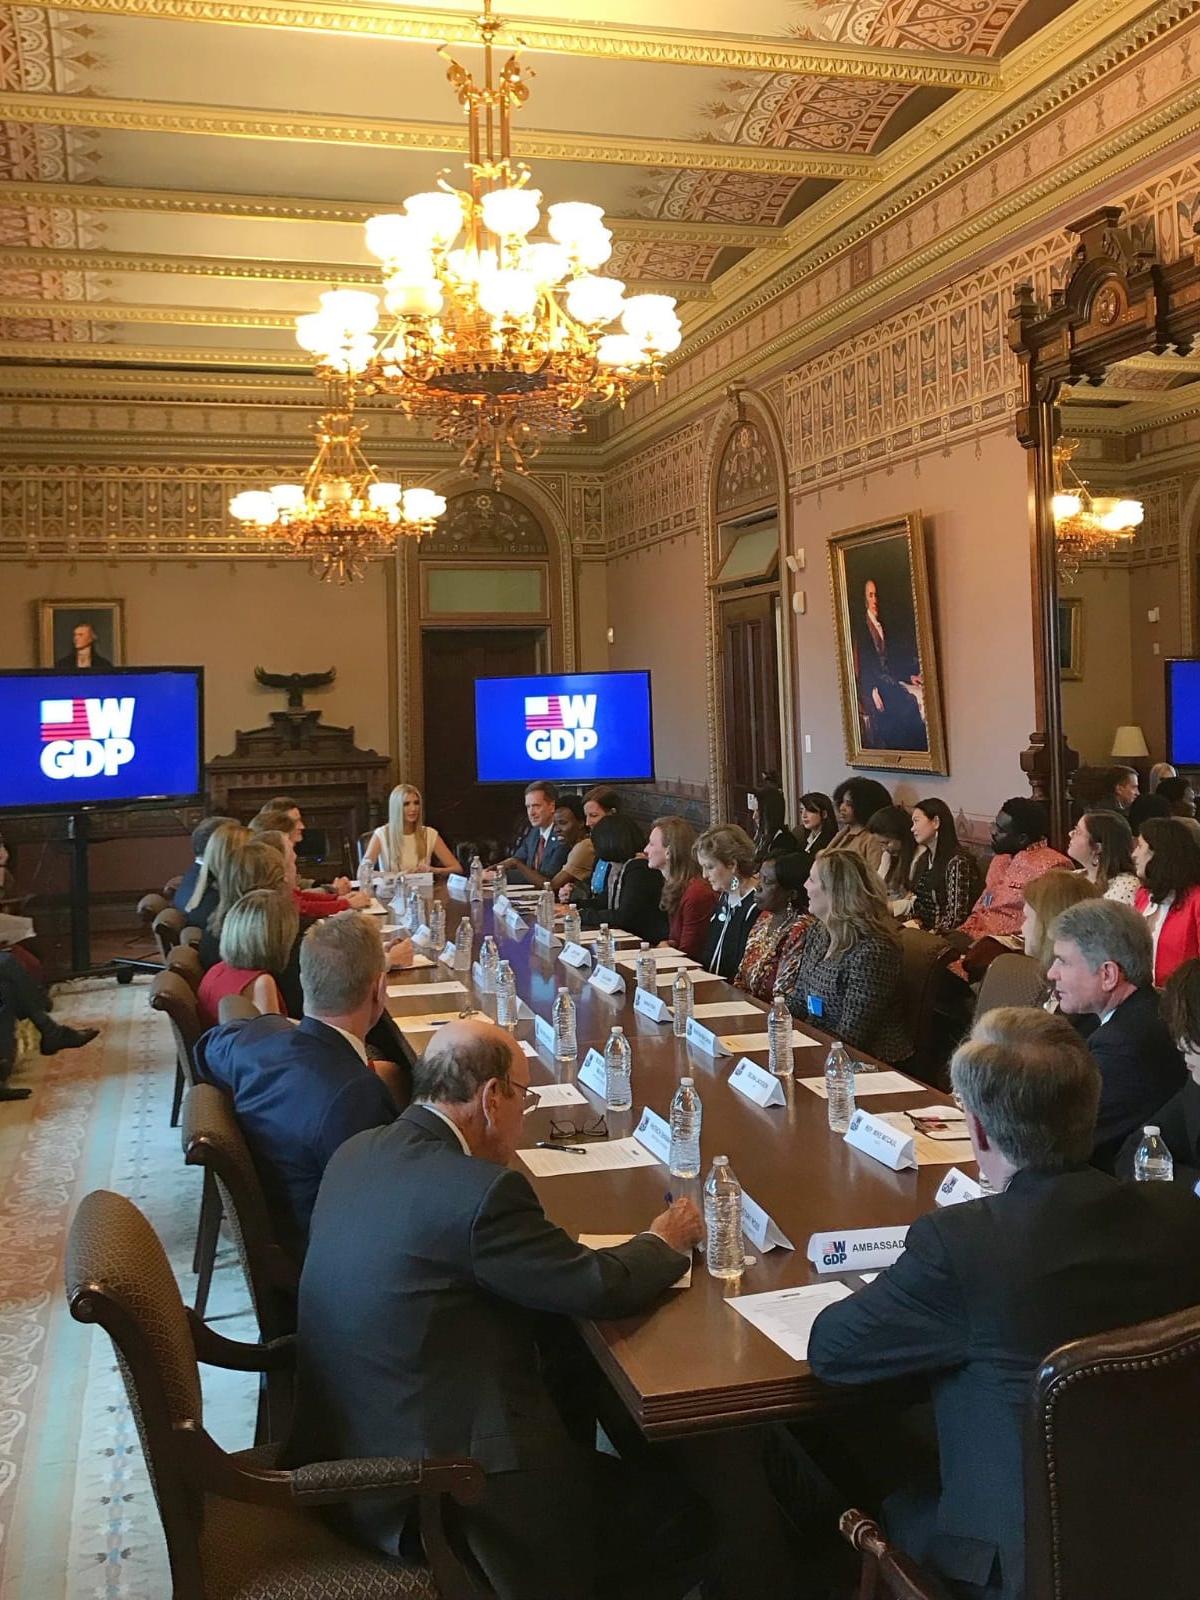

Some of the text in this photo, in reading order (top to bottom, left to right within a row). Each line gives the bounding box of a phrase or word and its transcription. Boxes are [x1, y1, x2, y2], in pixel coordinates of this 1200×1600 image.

[84, 697, 136, 739] W
[558, 694, 598, 729] W
[40, 738, 135, 780] GDP
[525, 728, 598, 761] GDP
[823, 1253, 847, 1265] GDP
[833, 1240, 846, 1253] W
[852, 1239, 906, 1252] AMBASSAD
